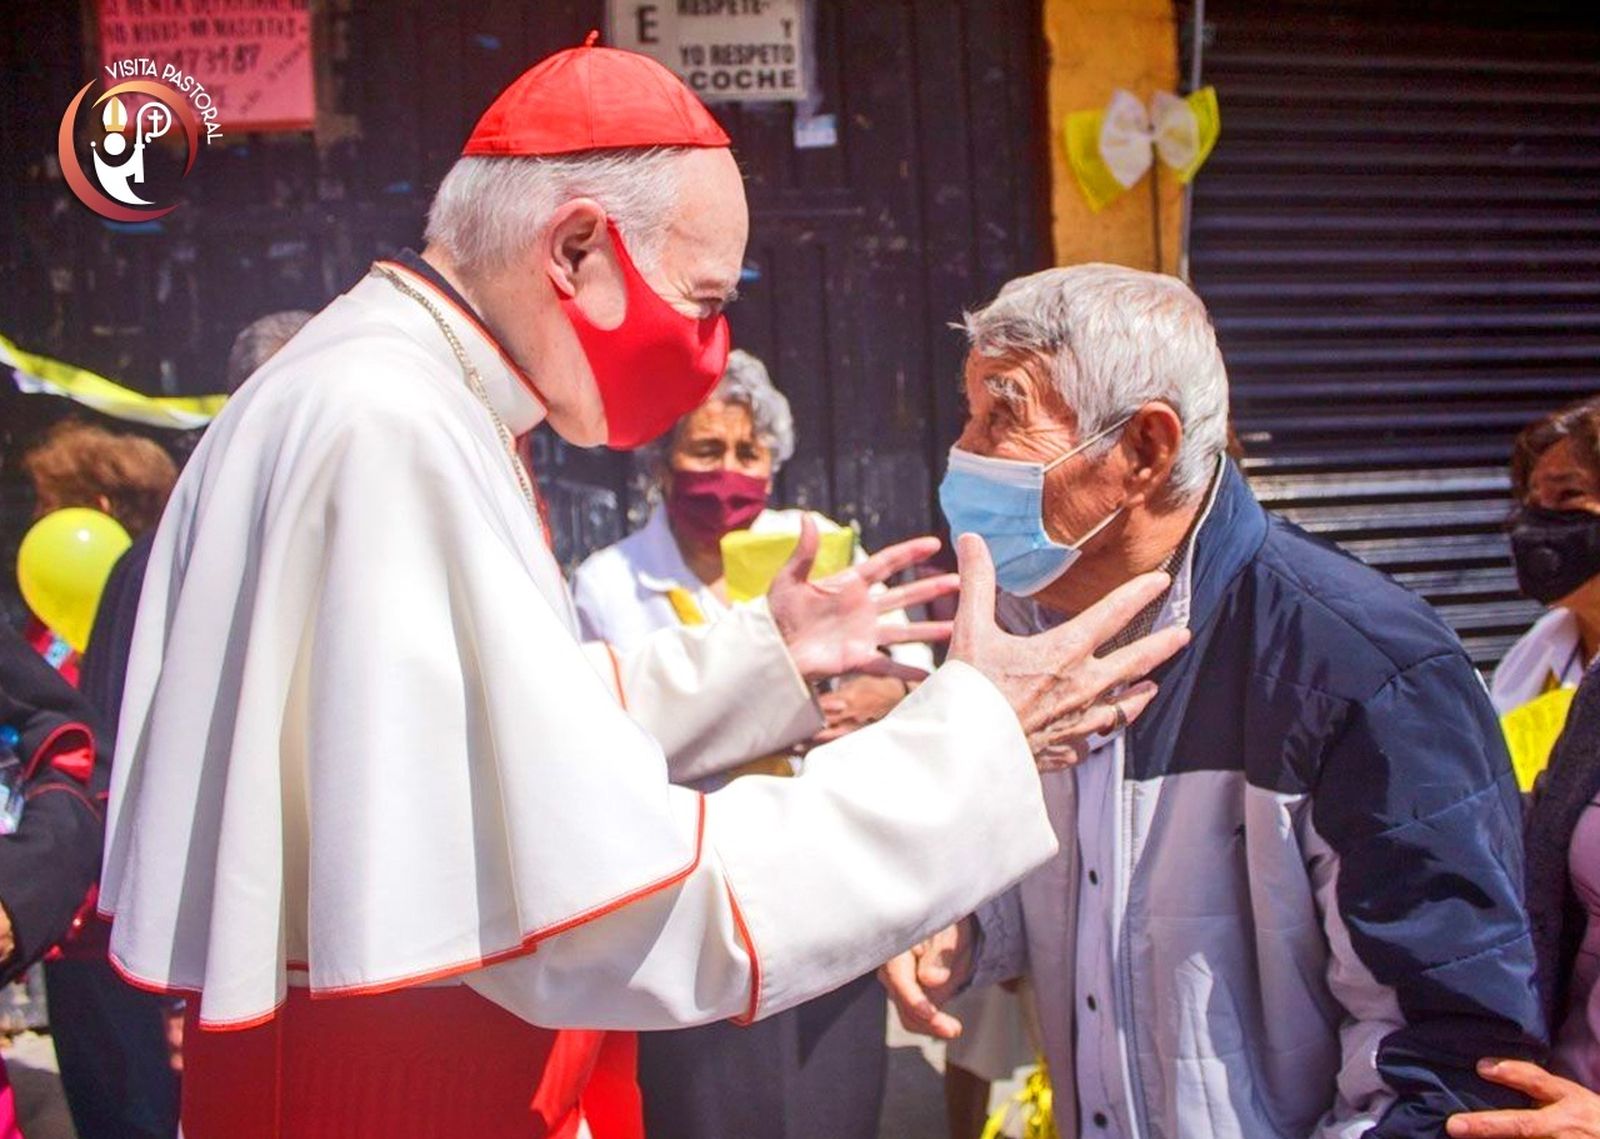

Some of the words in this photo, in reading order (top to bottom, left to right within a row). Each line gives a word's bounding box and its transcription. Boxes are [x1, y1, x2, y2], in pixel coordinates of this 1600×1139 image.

[635, 5, 660, 43] E
[680, 46, 706, 65] YO
[711, 45, 795, 65] RESPETO
[690, 69, 796, 90] COCHE
